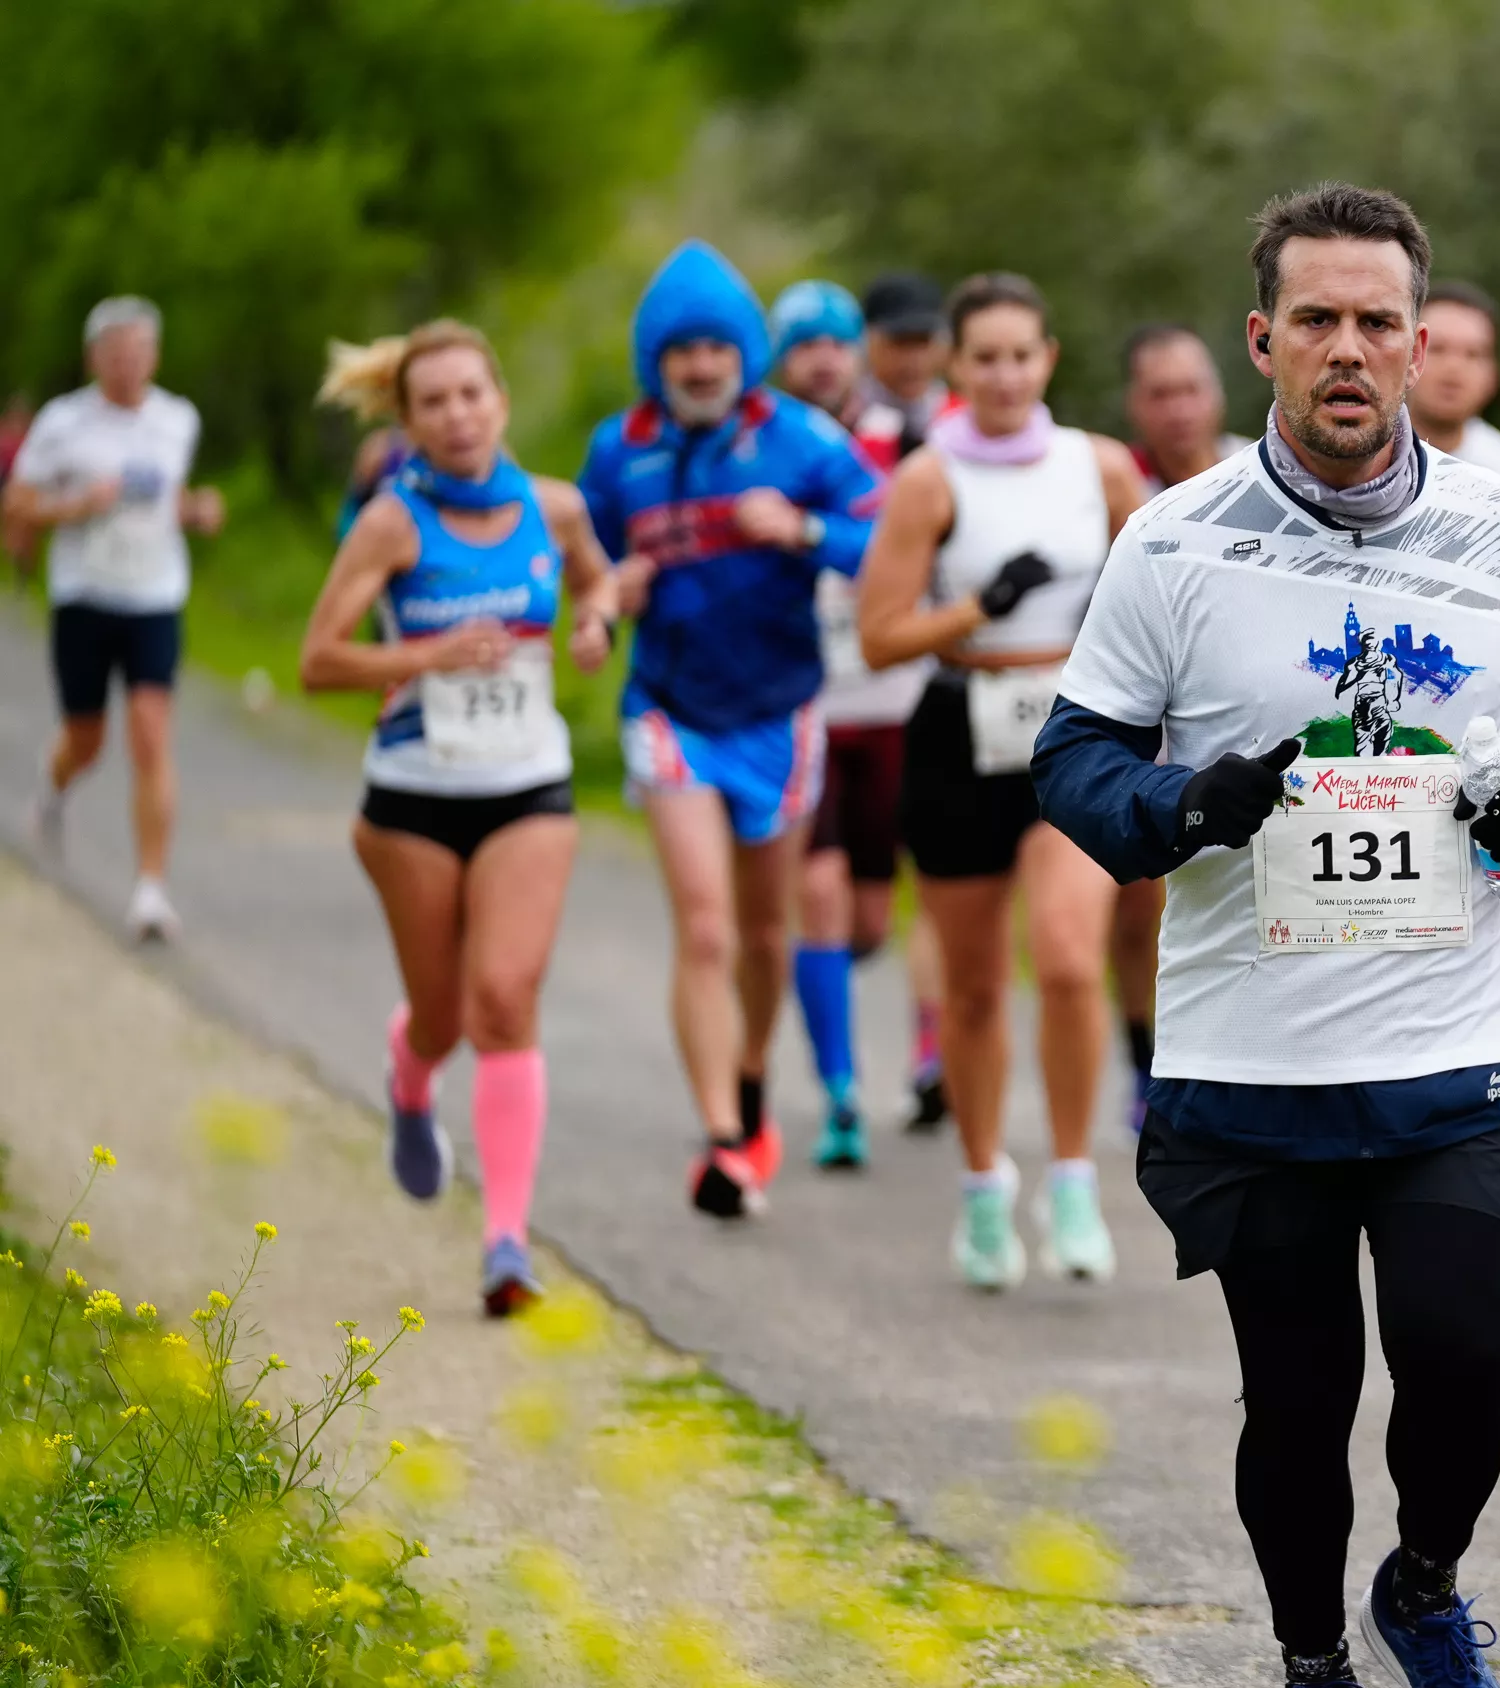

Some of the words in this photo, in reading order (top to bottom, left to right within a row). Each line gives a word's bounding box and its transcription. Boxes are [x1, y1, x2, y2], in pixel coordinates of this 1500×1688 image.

[1234, 540, 1259, 551] 42K
[1329, 775, 1359, 790] MEDIA
[1366, 774, 1419, 790] MARATÓN
[1338, 791, 1405, 812] LUCENA
[1311, 830, 1421, 882] 131
[1315, 898, 1335, 906] JUAN
[1336, 898, 1353, 906] LUIS
[1354, 896, 1392, 906] CAMPAÑA
[1394, 897, 1416, 905] LOPEZ
[1348, 908, 1384, 916] L-Hombre
